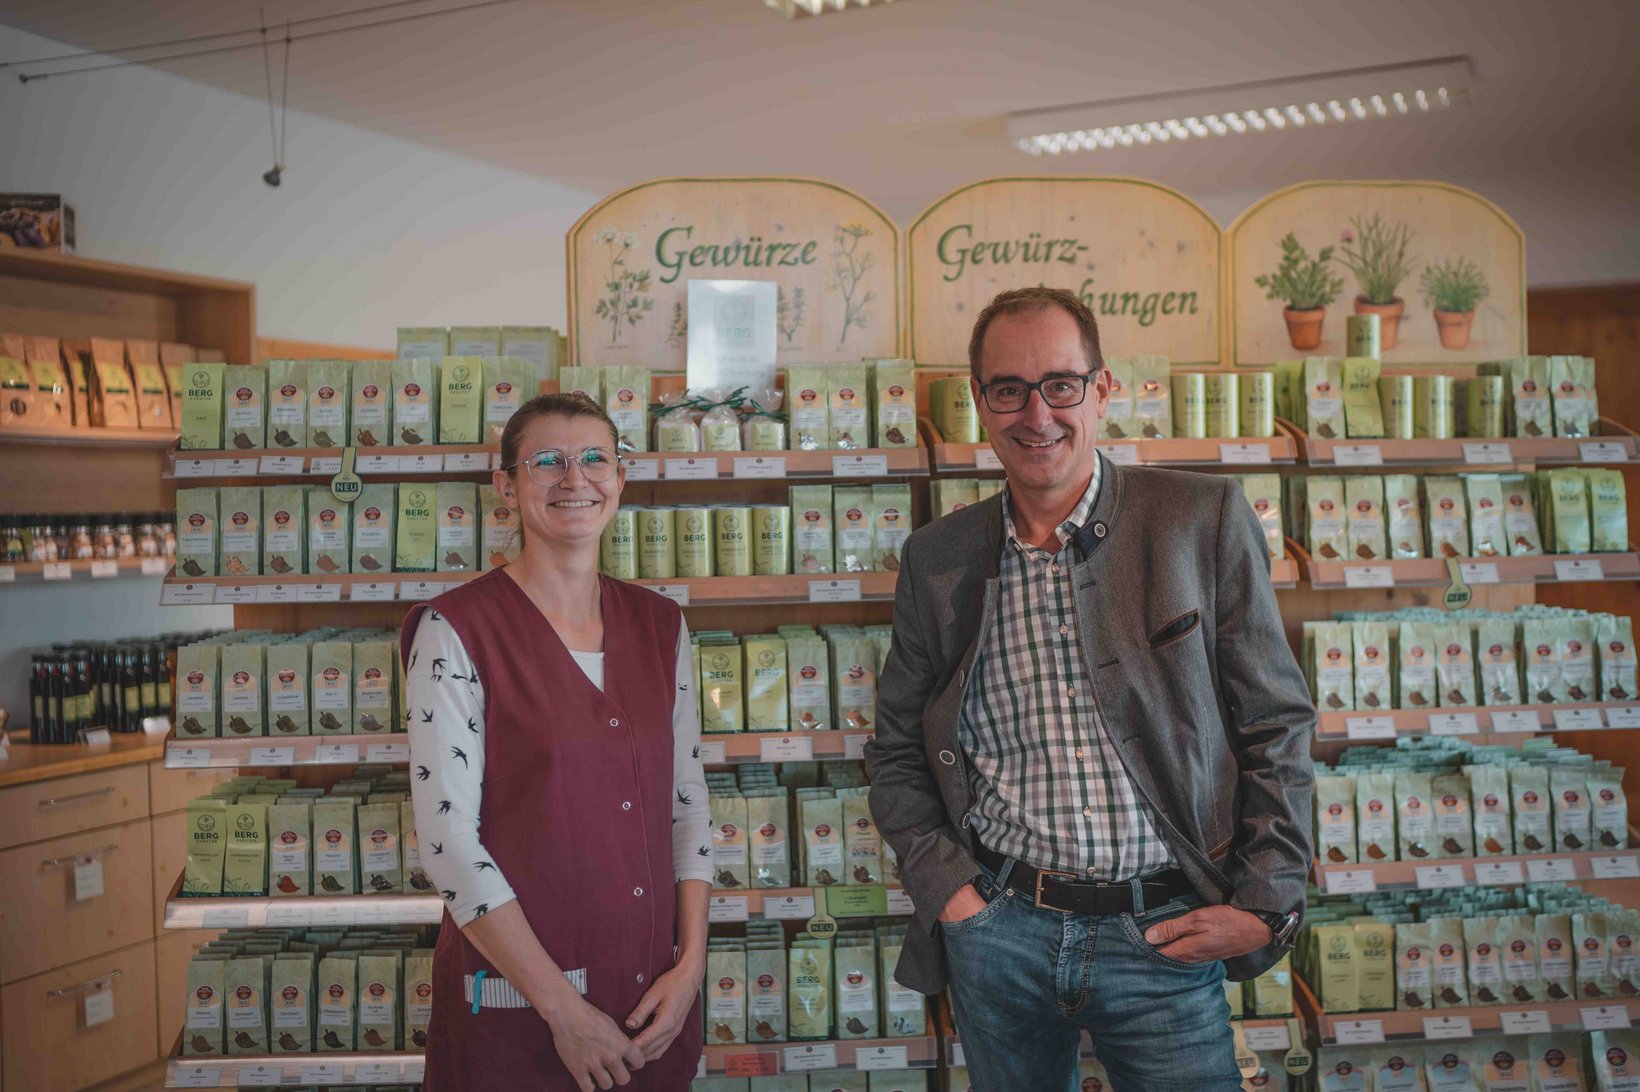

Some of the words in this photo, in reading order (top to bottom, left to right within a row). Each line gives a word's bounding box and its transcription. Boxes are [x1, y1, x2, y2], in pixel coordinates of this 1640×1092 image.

[655, 225, 818, 283] Gewürze
[936, 224, 1089, 282] Gewürz-
[1076, 278, 1198, 327] hungen
[448, 383, 472, 391] BERG
[188, 389, 213, 397] BERG
[336, 483, 357, 491] NEU
[645, 535, 668, 543] BERG
[684, 534, 706, 542] BERG
[721, 532, 743, 540] BERG
[709, 671, 734, 679] BERG
[755, 668, 780, 677] BERG
[193, 832, 219, 840] BERG
